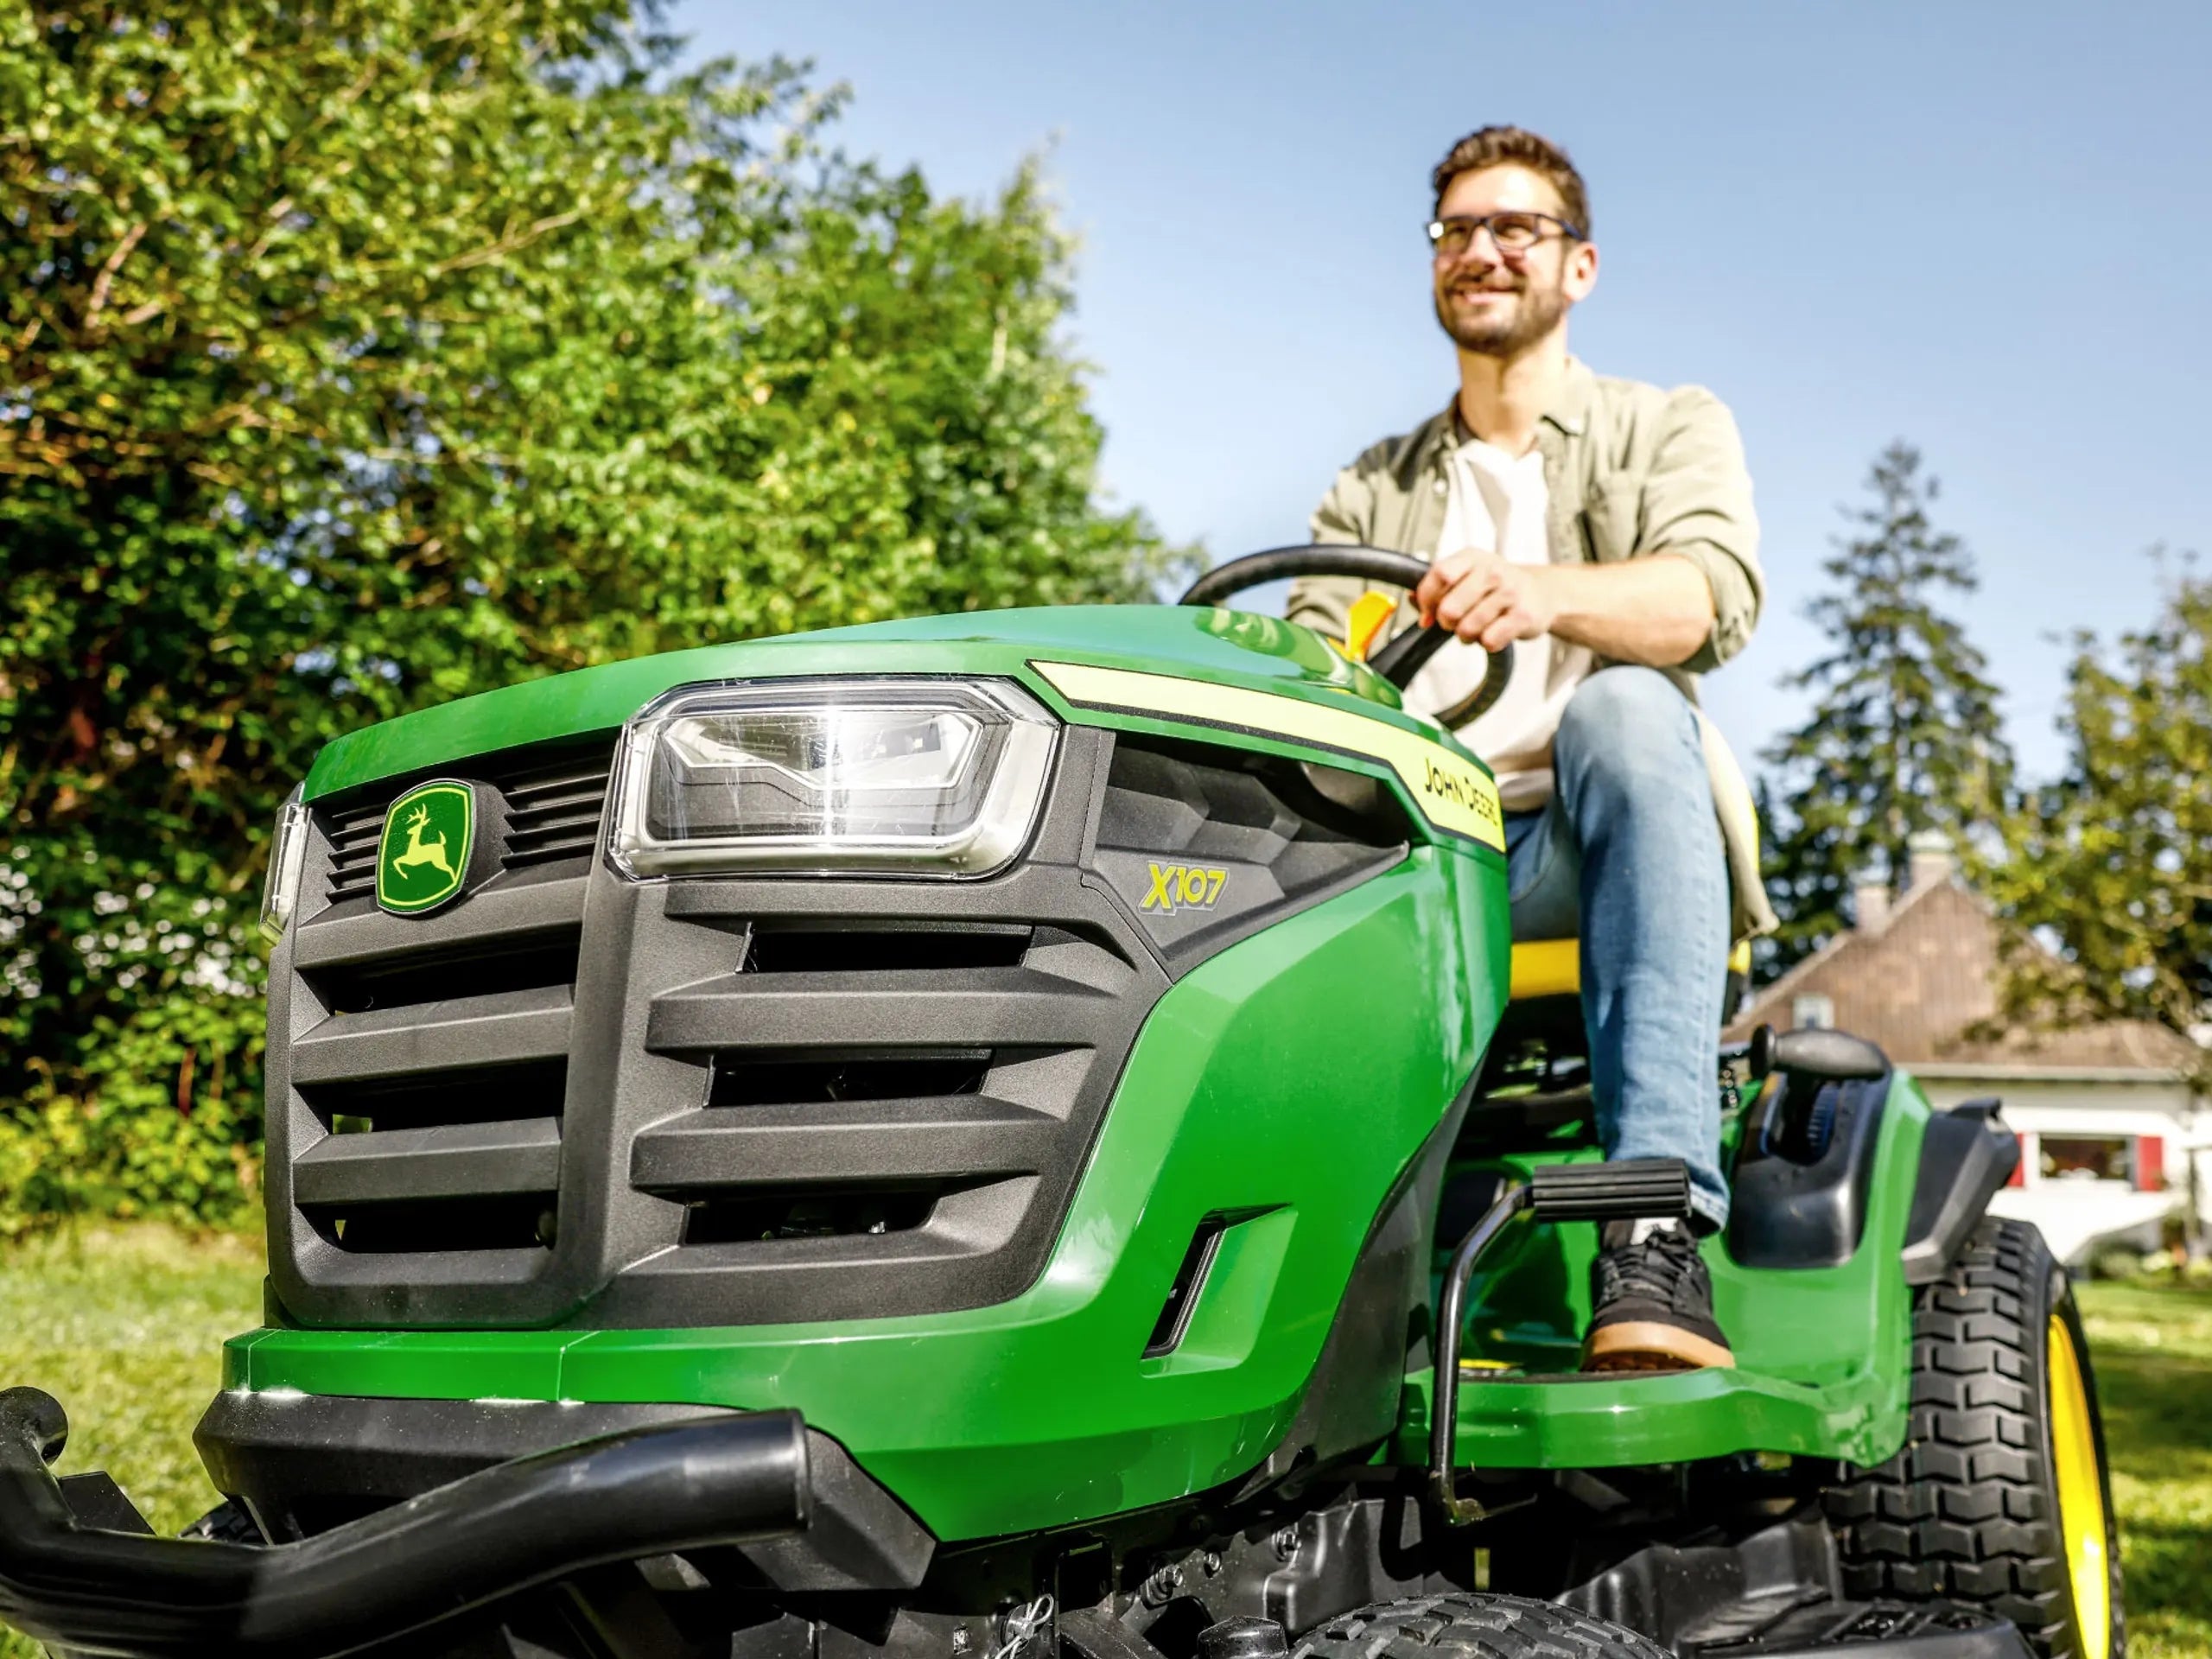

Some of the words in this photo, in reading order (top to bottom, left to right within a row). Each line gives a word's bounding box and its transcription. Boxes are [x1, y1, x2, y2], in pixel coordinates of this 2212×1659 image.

[1424, 757, 1465, 804] JOHN
[1464, 776, 1499, 827] DEER
[1140, 861, 1227, 912] X107
